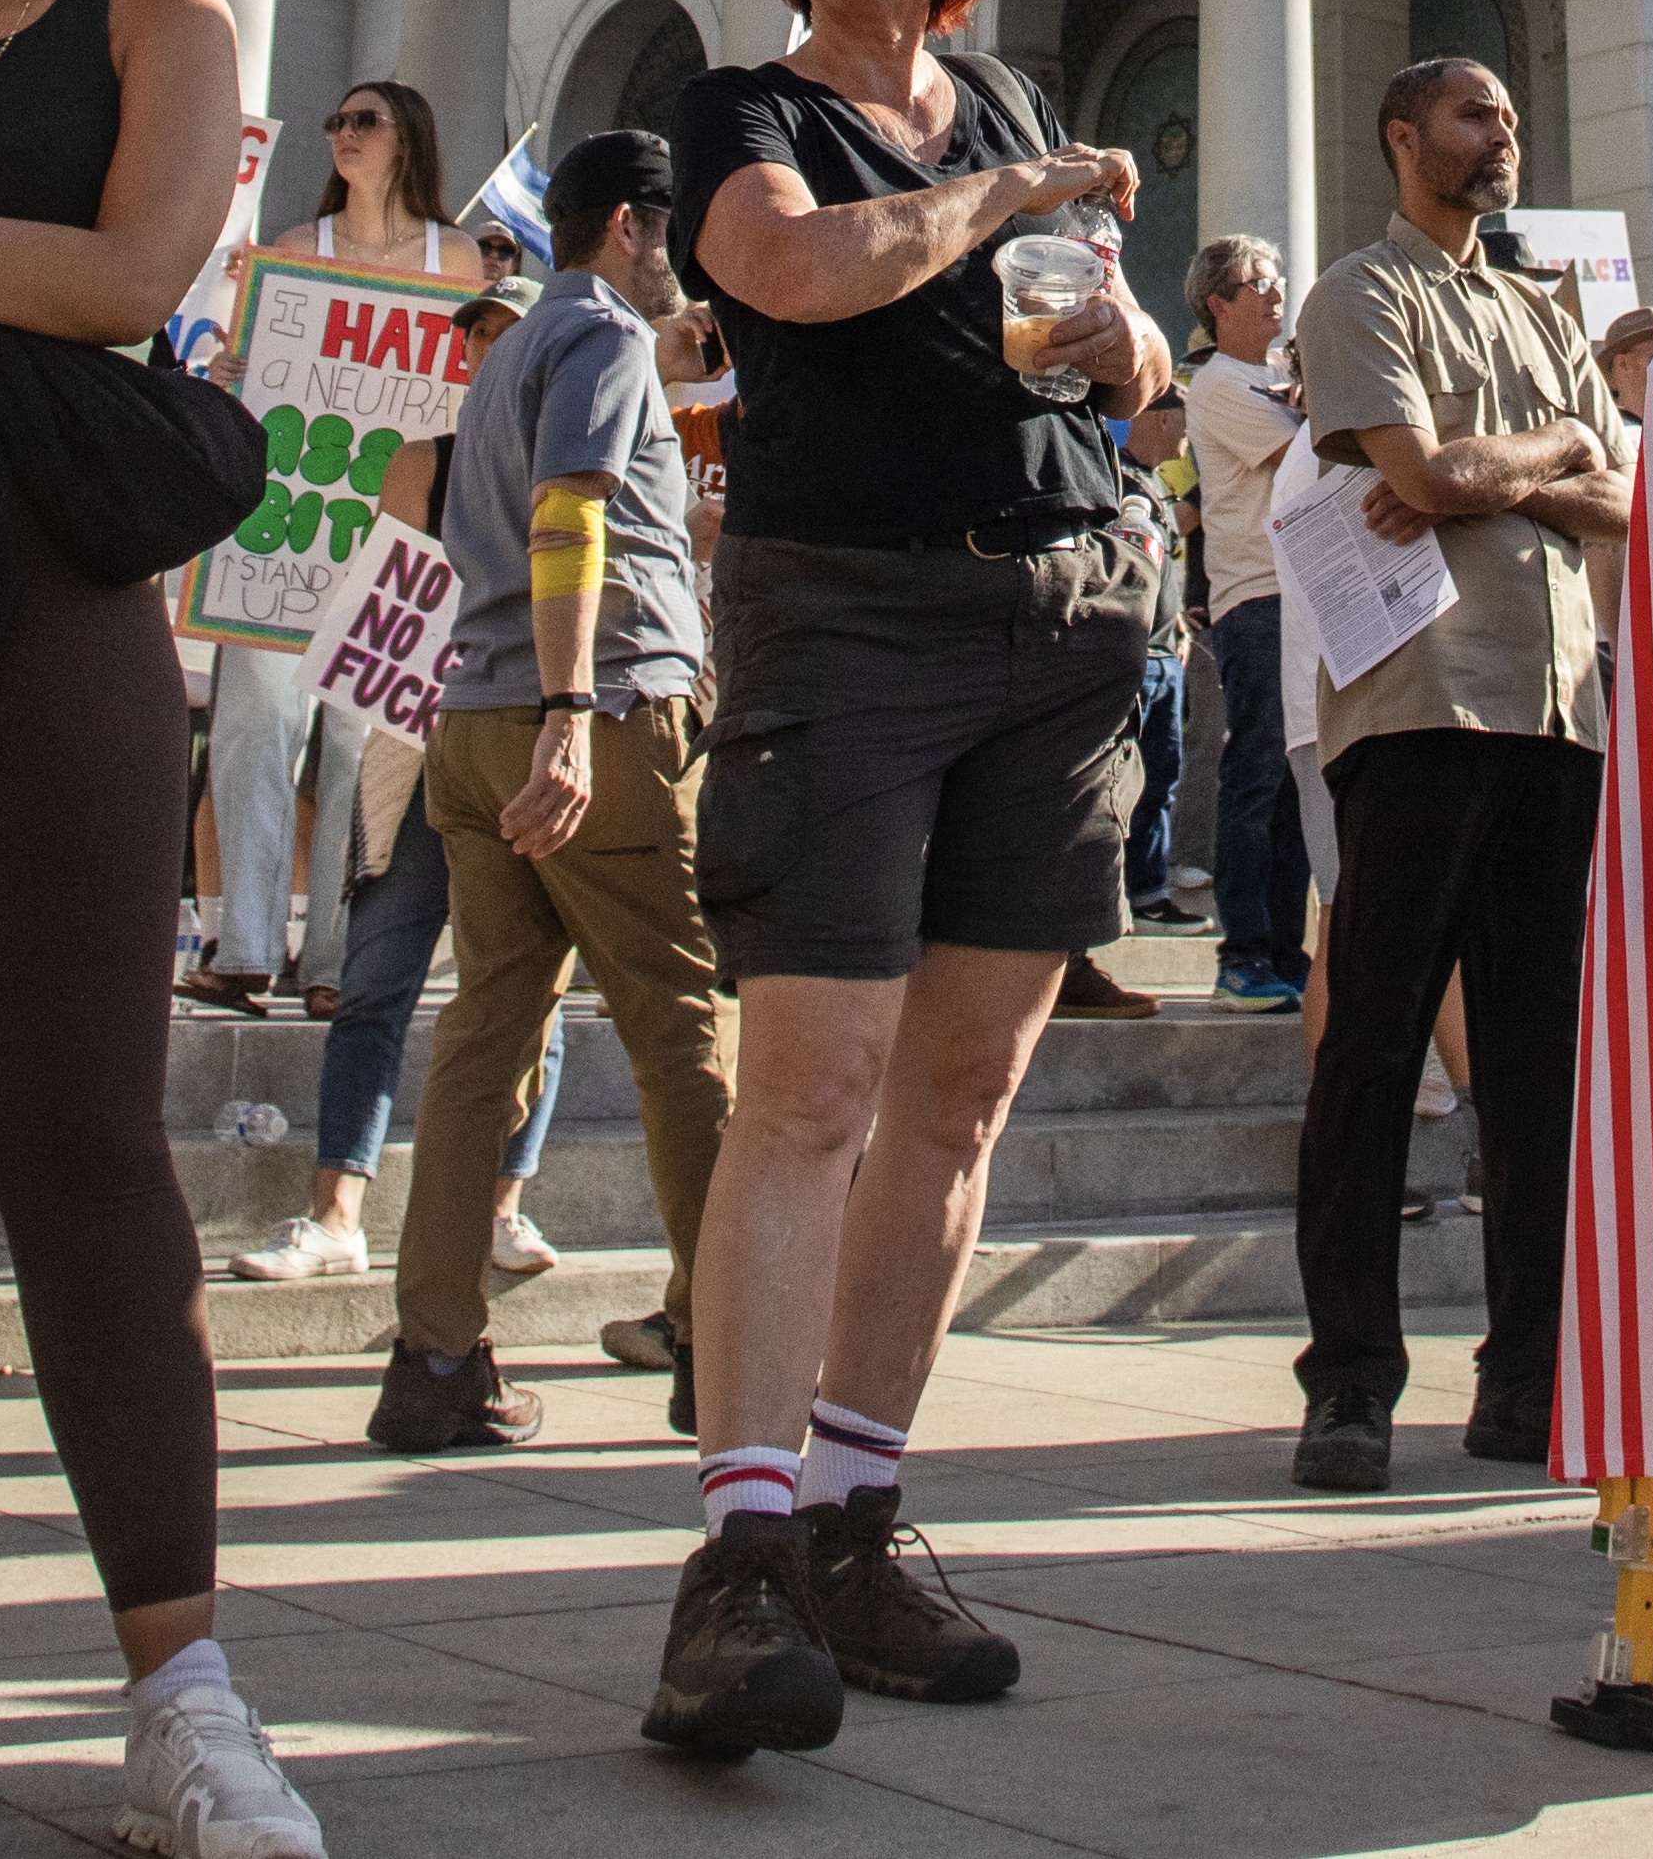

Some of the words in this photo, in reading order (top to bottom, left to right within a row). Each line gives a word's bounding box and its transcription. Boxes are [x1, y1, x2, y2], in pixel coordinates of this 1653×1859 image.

[269, 289, 308, 339] I
[304, 361, 450, 429] NEUTRA
[234, 479, 376, 564] BIT
[240, 553, 333, 593] STAND
[241, 584, 320, 623] UP
[373, 537, 454, 614] NO
[346, 591, 426, 663] NO
[317, 640, 441, 742] FUCK
